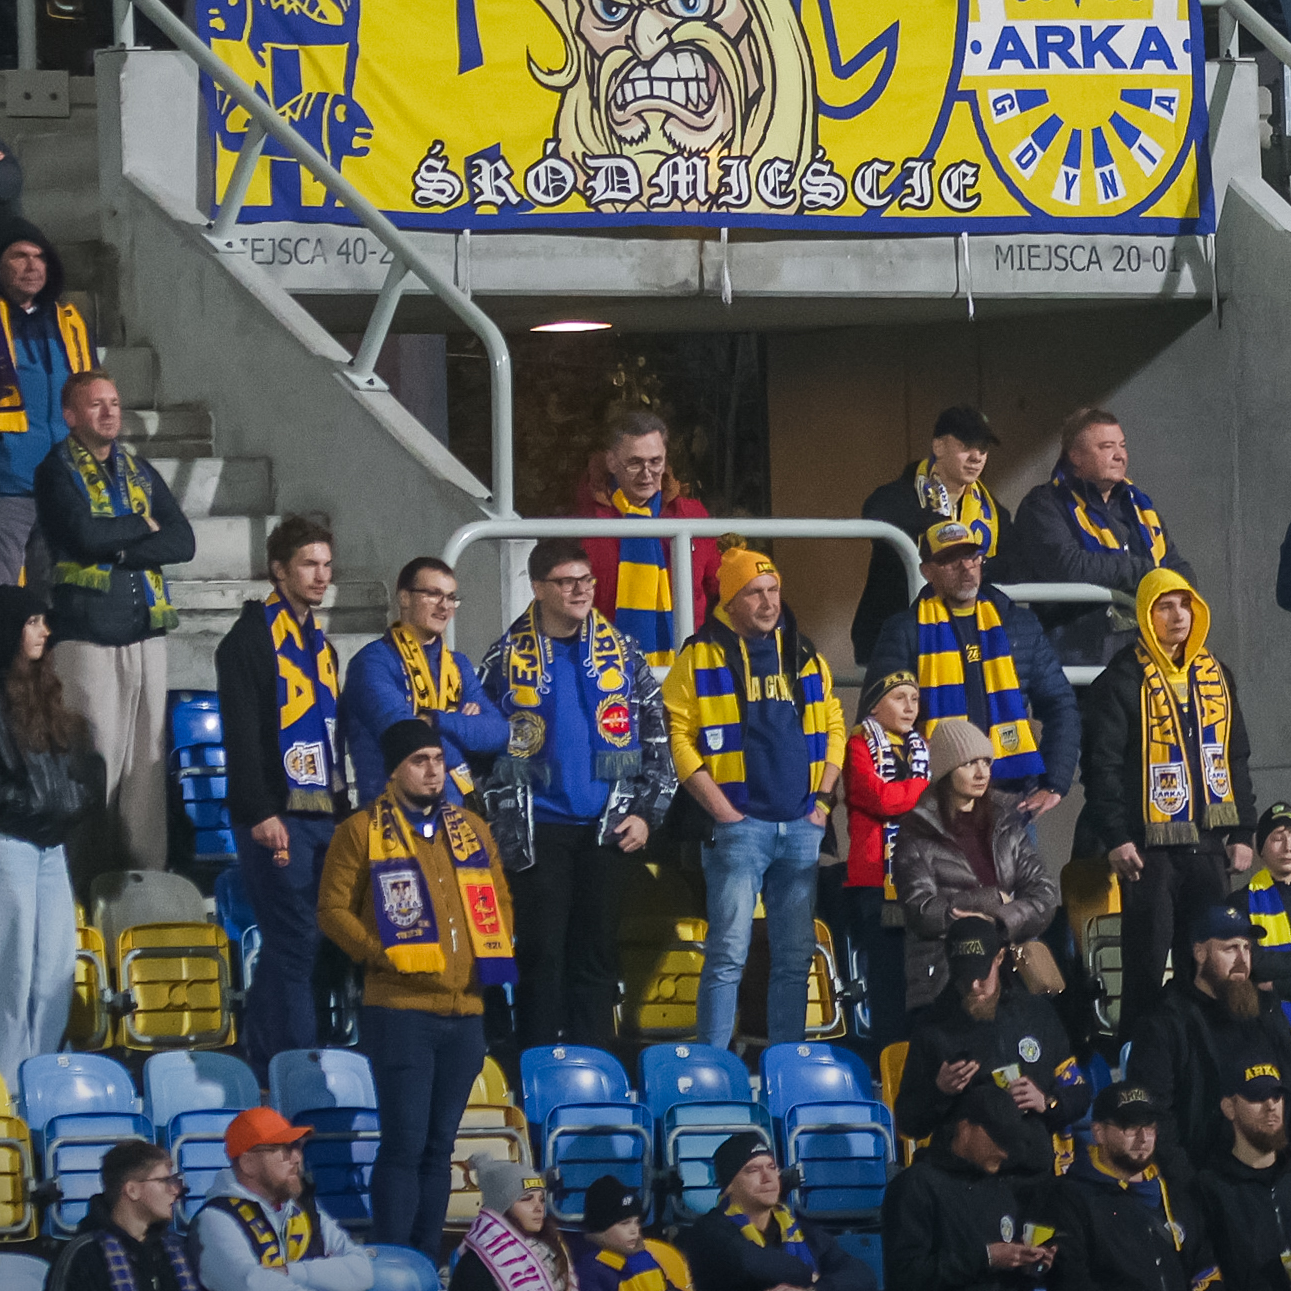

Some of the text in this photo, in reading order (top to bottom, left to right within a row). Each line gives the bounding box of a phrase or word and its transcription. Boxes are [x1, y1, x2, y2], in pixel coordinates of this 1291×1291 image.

[987, 24, 1179, 70] ARKA
[992, 93, 1177, 201] GDYNIA
[412, 140, 982, 213] ŚRÓDMIEŚCIE
[240, 237, 328, 266] EJSCA
[994, 244, 1181, 273] MIEJSCA 20-01
[1244, 1063, 1281, 1082] ARKA
